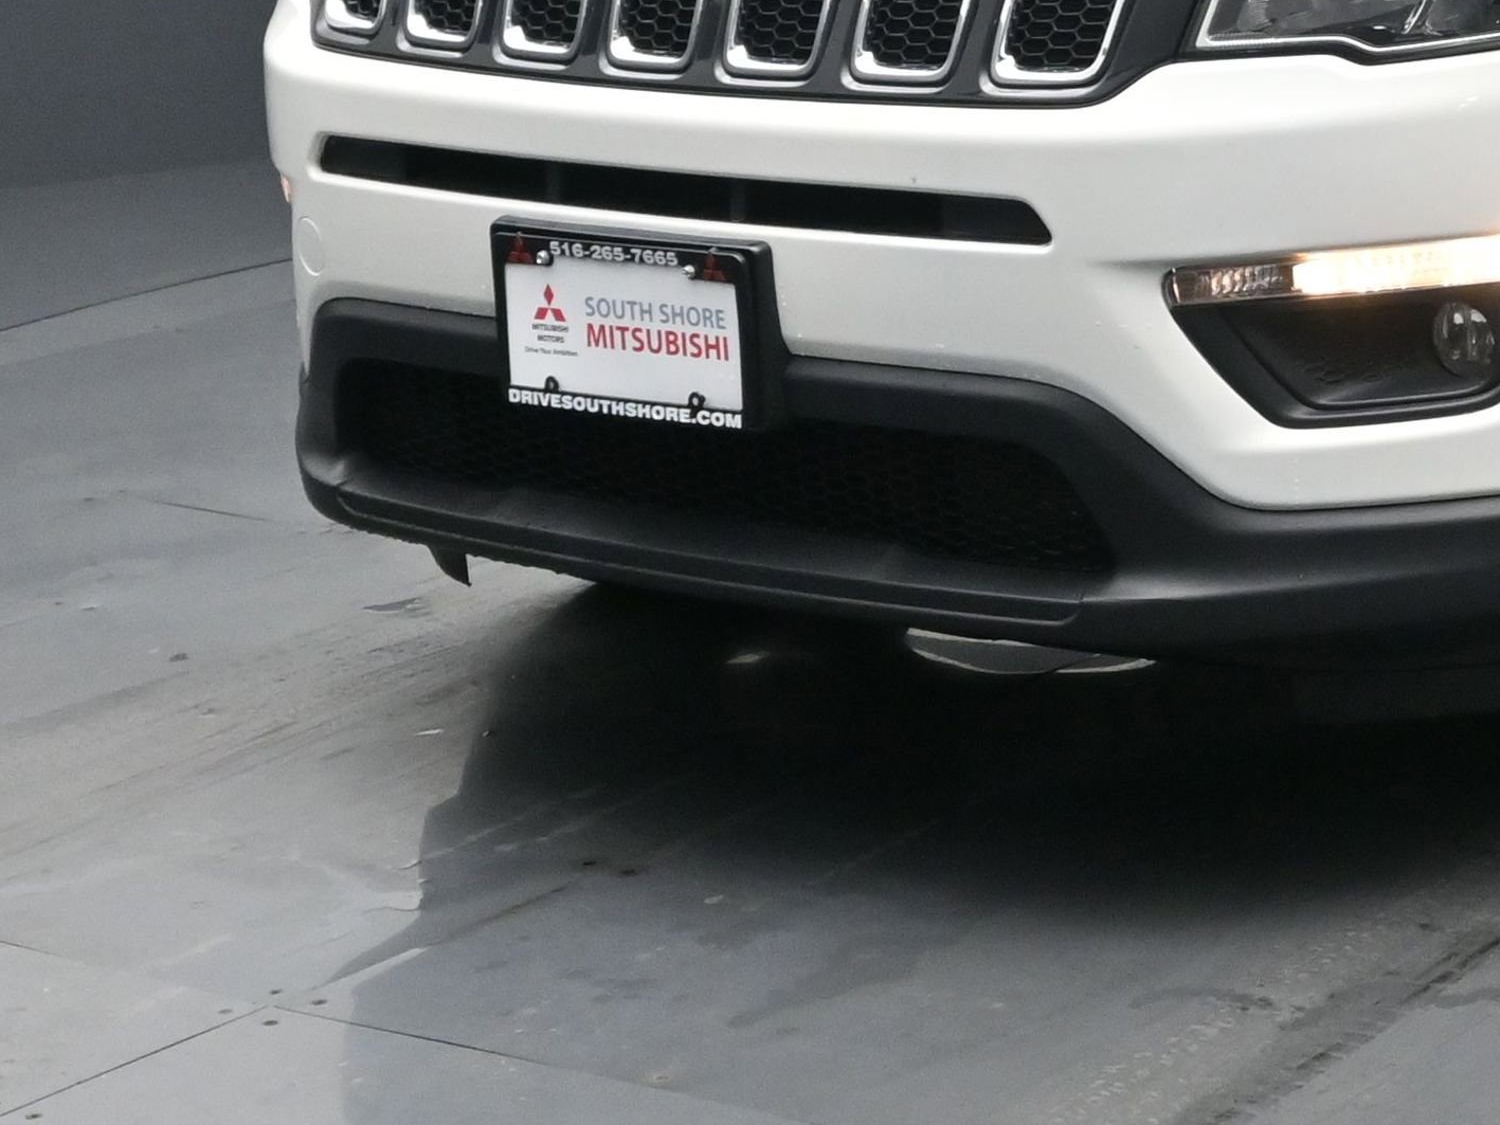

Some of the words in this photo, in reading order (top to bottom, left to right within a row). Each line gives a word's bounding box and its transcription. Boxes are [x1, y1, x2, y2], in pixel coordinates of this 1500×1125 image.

[548, 241, 679, 267] 516-265-7665
[584, 296, 653, 323] SOUTH
[658, 303, 727, 330] SHORE
[586, 323, 730, 362] MITSUBISHI
[508, 387, 743, 429] DRIVESOUTHSHORE.COM
